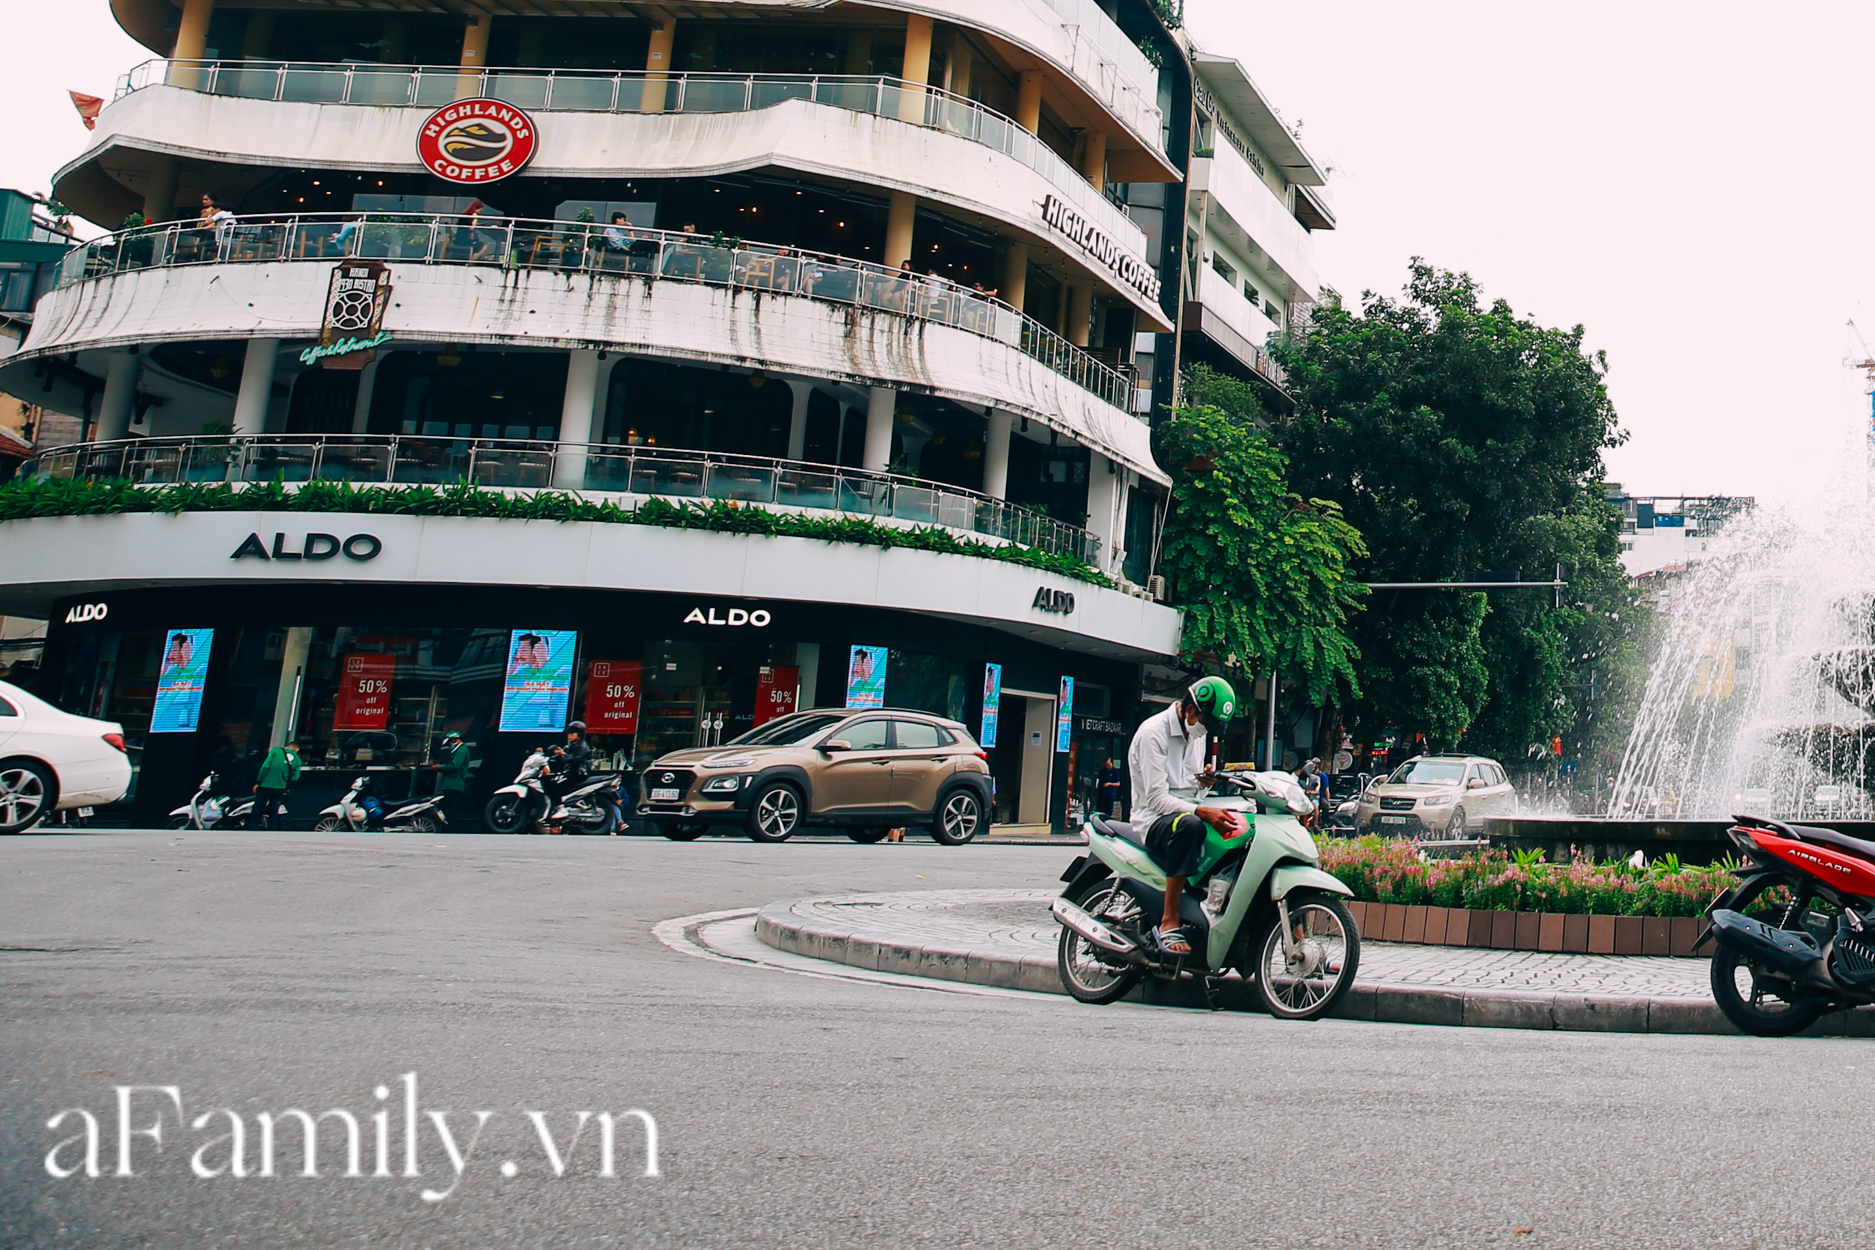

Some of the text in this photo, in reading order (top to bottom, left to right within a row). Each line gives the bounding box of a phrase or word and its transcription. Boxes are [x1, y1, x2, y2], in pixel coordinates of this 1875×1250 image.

[425, 104, 530, 139] HIGHLANDS
[433, 159, 514, 180] COFFEE
[1042, 194, 1162, 303] HIGHLANDS COFFEE
[229, 532, 383, 561] ALDO
[1032, 586, 1075, 614] ALDO
[65, 603, 108, 623] ALDO
[683, 607, 772, 627] ALDO
[358, 679, 388, 694] 50%
[606, 684, 635, 698] 50%
[770, 690, 792, 703] 50%
[366, 696, 377, 704] off
[614, 701, 625, 709] off
[355, 707, 384, 716] original
[604, 710, 633, 719] original
[1788, 849, 1852, 874] AIRBLADE
